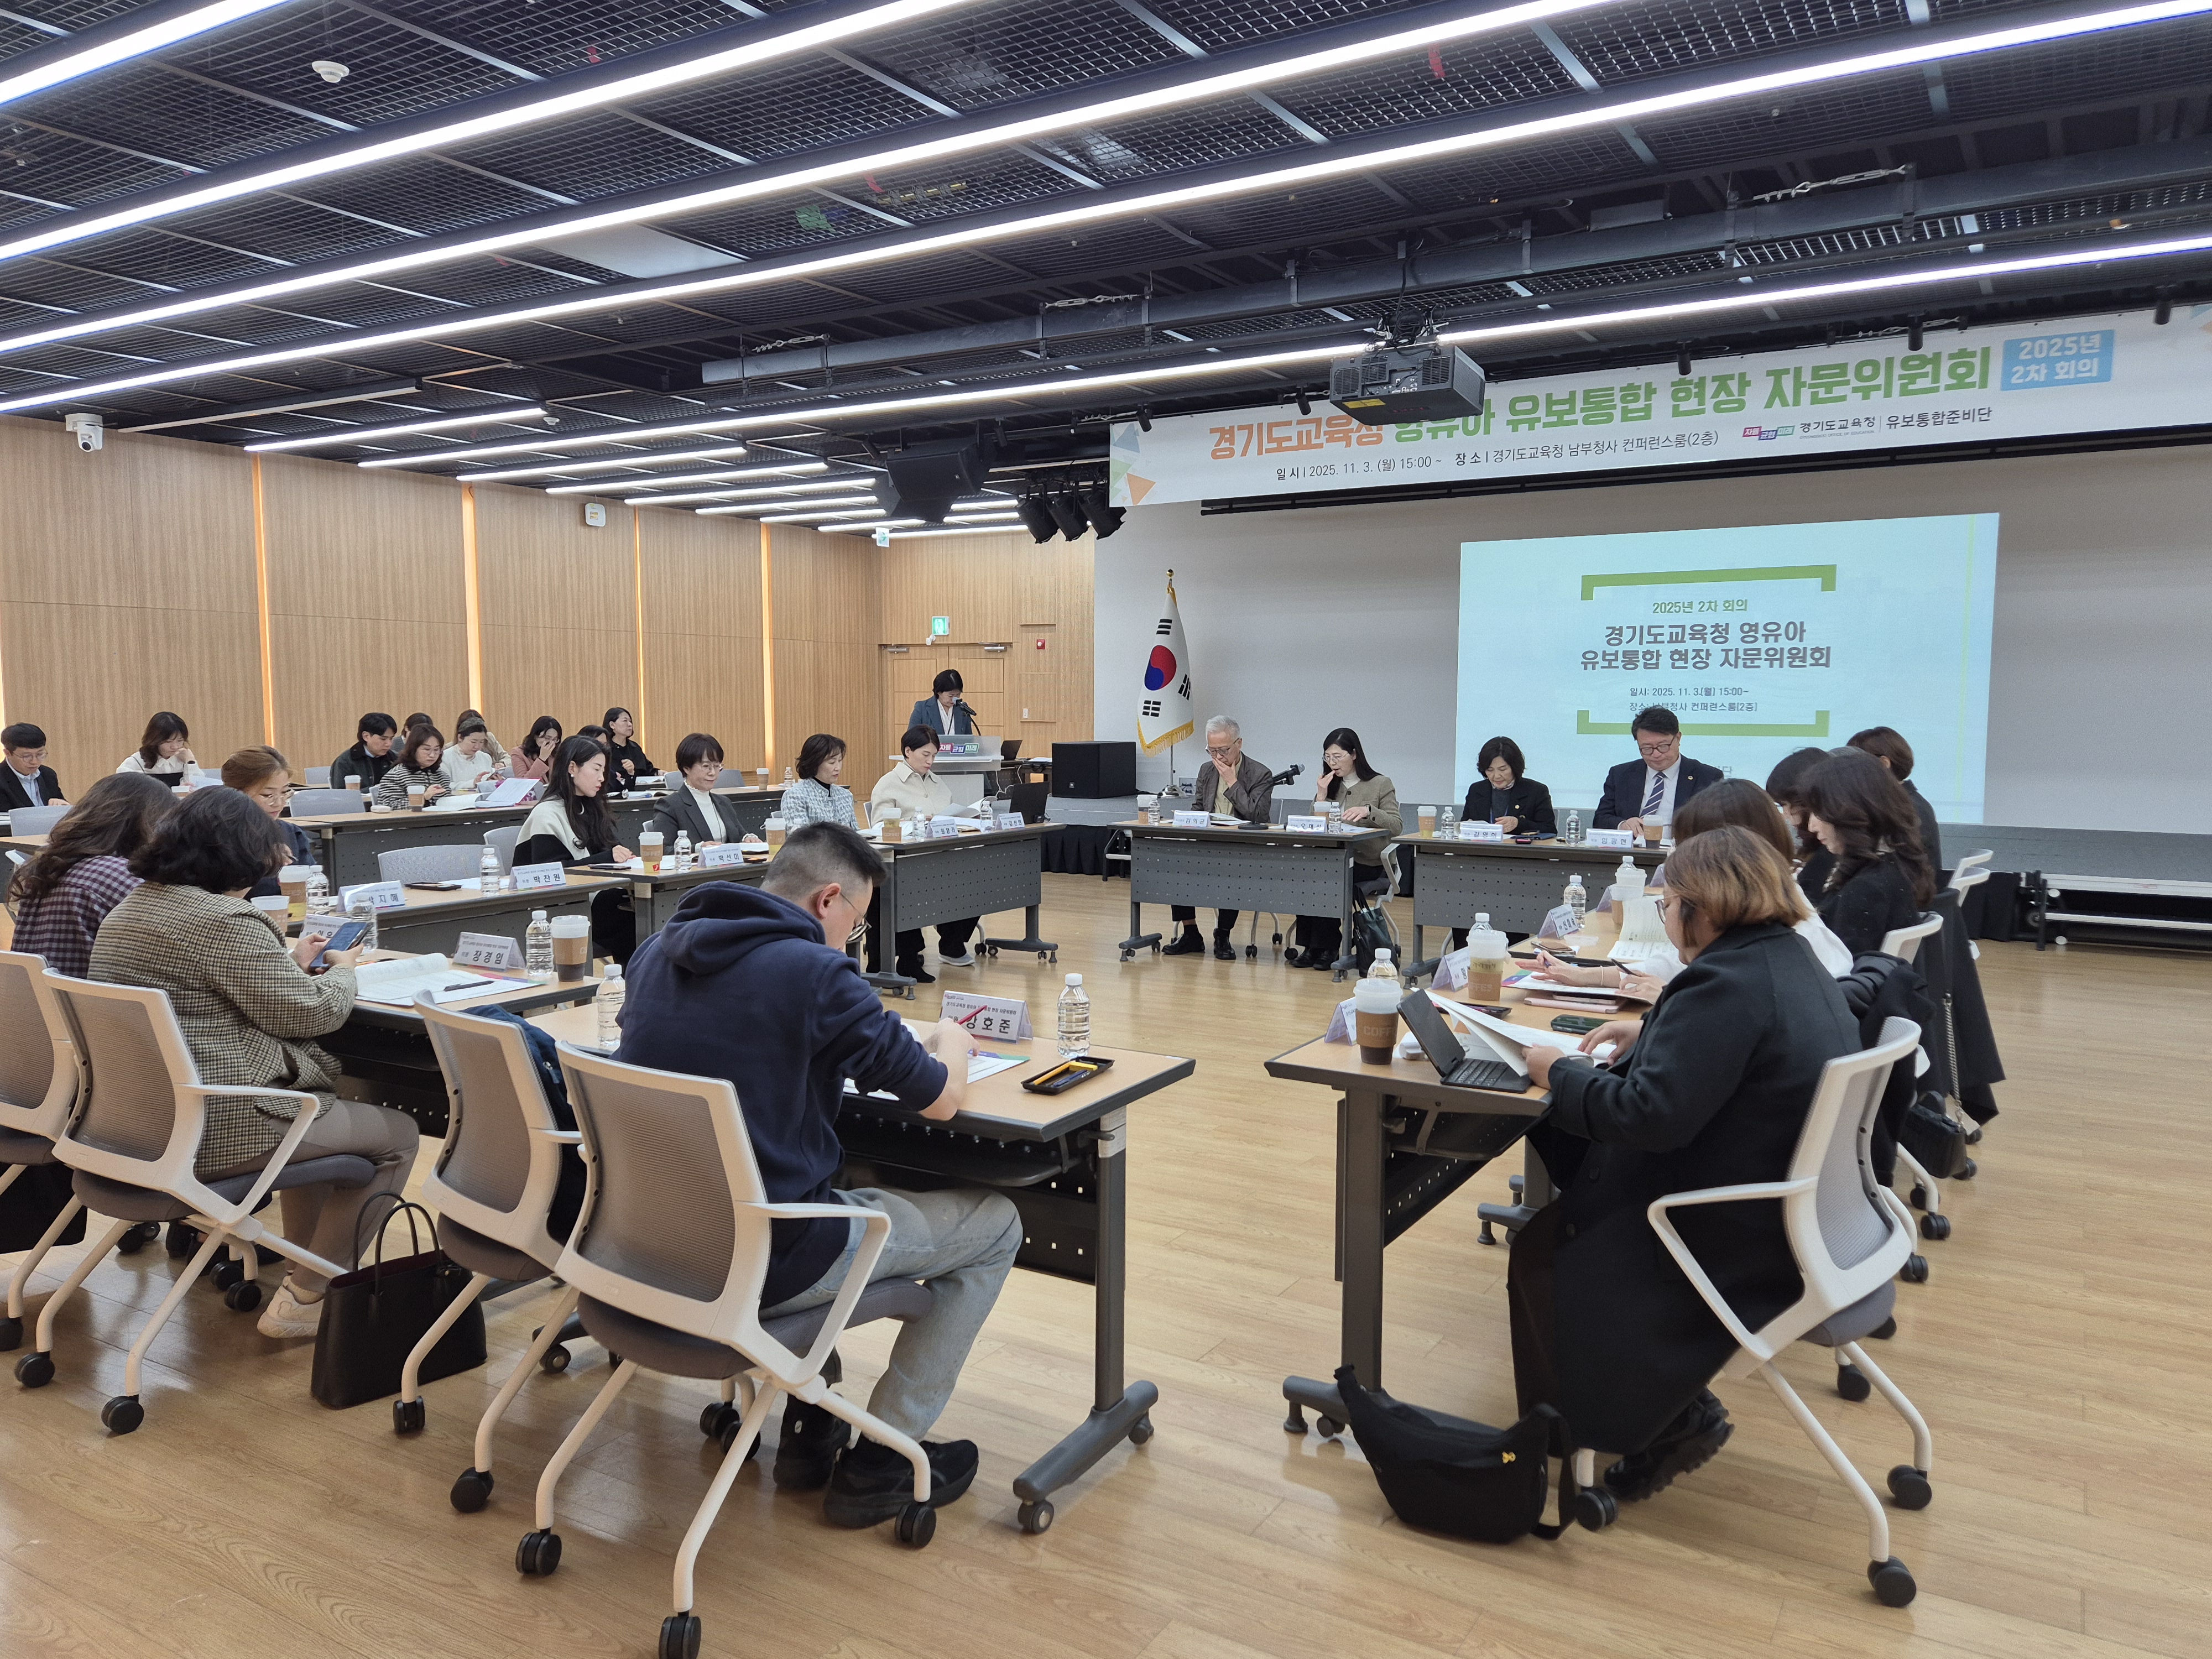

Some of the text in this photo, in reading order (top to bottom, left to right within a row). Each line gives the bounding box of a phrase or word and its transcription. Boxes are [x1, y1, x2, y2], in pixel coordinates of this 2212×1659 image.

[2019, 333, 2101, 359] 2025년
[2011, 357, 2099, 384] 2차 회의
[1506, 381, 1657, 432] 유보통합
[1671, 371, 1751, 418] 현장
[1763, 346, 1991, 409] 자문위원회
[1800, 416, 1875, 433] 경기도교육청
[1885, 406, 1992, 429] 유보통합준비단
[1310, 464, 1338, 478] 2025.
[1344, 462, 1359, 474] 11.
[1363, 461, 1373, 473] 3.
[1378, 458, 1395, 473] (월)
[1400, 456, 1432, 469] 15:00
[1493, 444, 1563, 463] 경기도교육청
[1568, 439, 1618, 457] 남부청사
[1622, 431, 1719, 452] 컨퍼런스룸(2층)
[1652, 599, 1749, 614] 2025년 2차 회의
[1605, 620, 1807, 646] 경기도교육청 영유아
[1580, 645, 1832, 671] 유보통합 현장 자문위원회
[1630, 687, 1649, 697] 일시:
[1652, 687, 1676, 696] 2025.
[1679, 687, 1691, 696] 11.
[472, 950, 504, 964] 장경임
